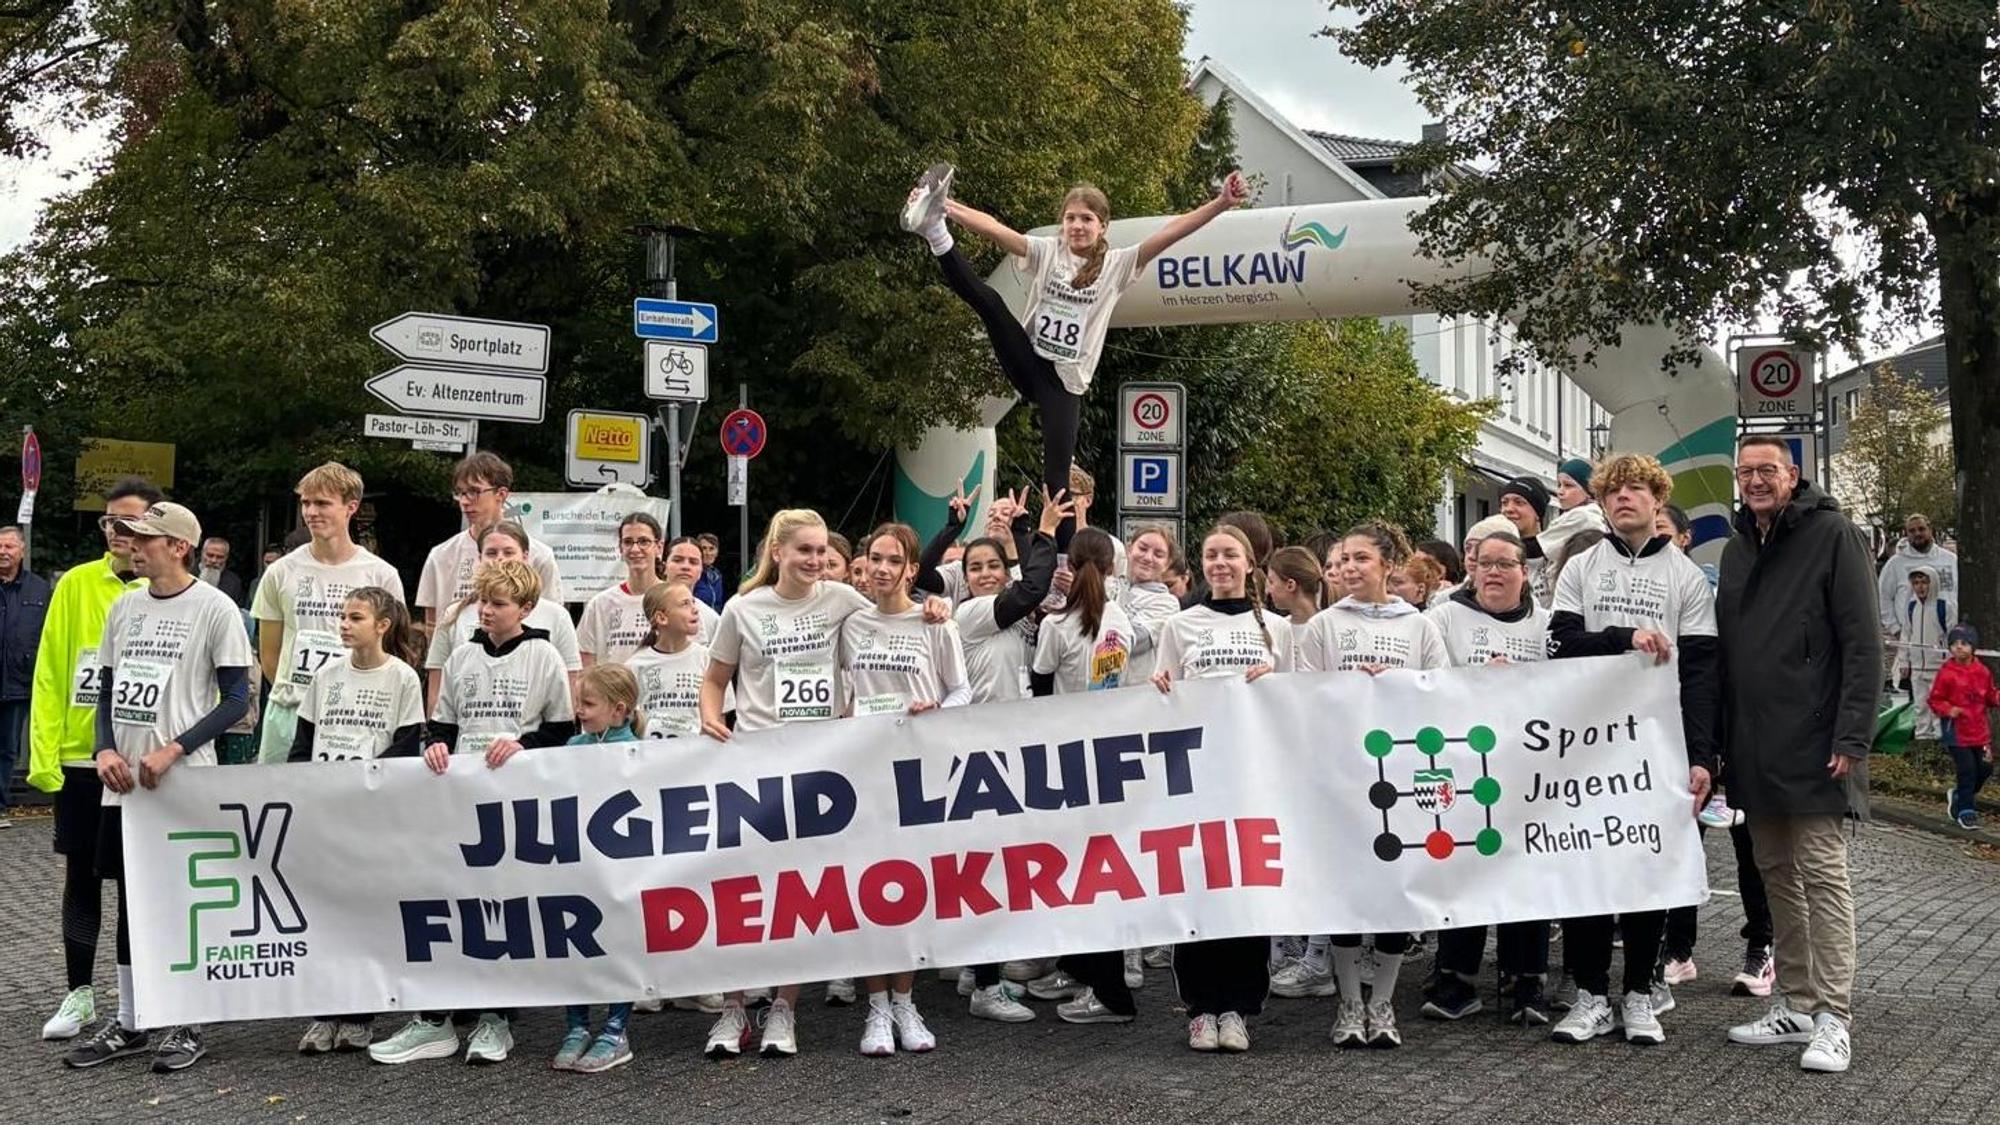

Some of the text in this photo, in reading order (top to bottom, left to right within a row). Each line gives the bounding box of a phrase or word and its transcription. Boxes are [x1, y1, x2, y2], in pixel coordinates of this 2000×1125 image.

[1158, 250, 1306, 289] BELKAW
[1161, 295, 1178, 306] Im
[1180, 294, 1222, 306] Herzen
[1039, 315, 1080, 346] 218
[450, 333, 523, 356] Sportplatz
[1762, 363, 1791, 385] 20
[431, 382, 525, 406] Altenzentrum
[1758, 399, 1796, 413] ZONE
[1141, 403, 1162, 420] 20
[371, 418, 462, 438] Pastor-Löh-Str.
[584, 426, 632, 445] Netto
[1137, 431, 1165, 442] ZONE
[1140, 462, 1161, 490] P
[1136, 495, 1165, 506] ZONE
[296, 648, 345, 673] 17
[117, 680, 160, 708] 320
[780, 679, 830, 704] 266
[1523, 714, 1639, 759] Sport
[1523, 758, 1653, 808] Jugend
[459, 726, 1204, 868] JUGEND LÄUFT
[1523, 815, 1663, 855] Rhein-Berg
[399, 817, 1285, 963] FÜR DEMOKRATIE
[205, 941, 308, 962] FAIREINS
[206, 961, 295, 981] KULTUR
